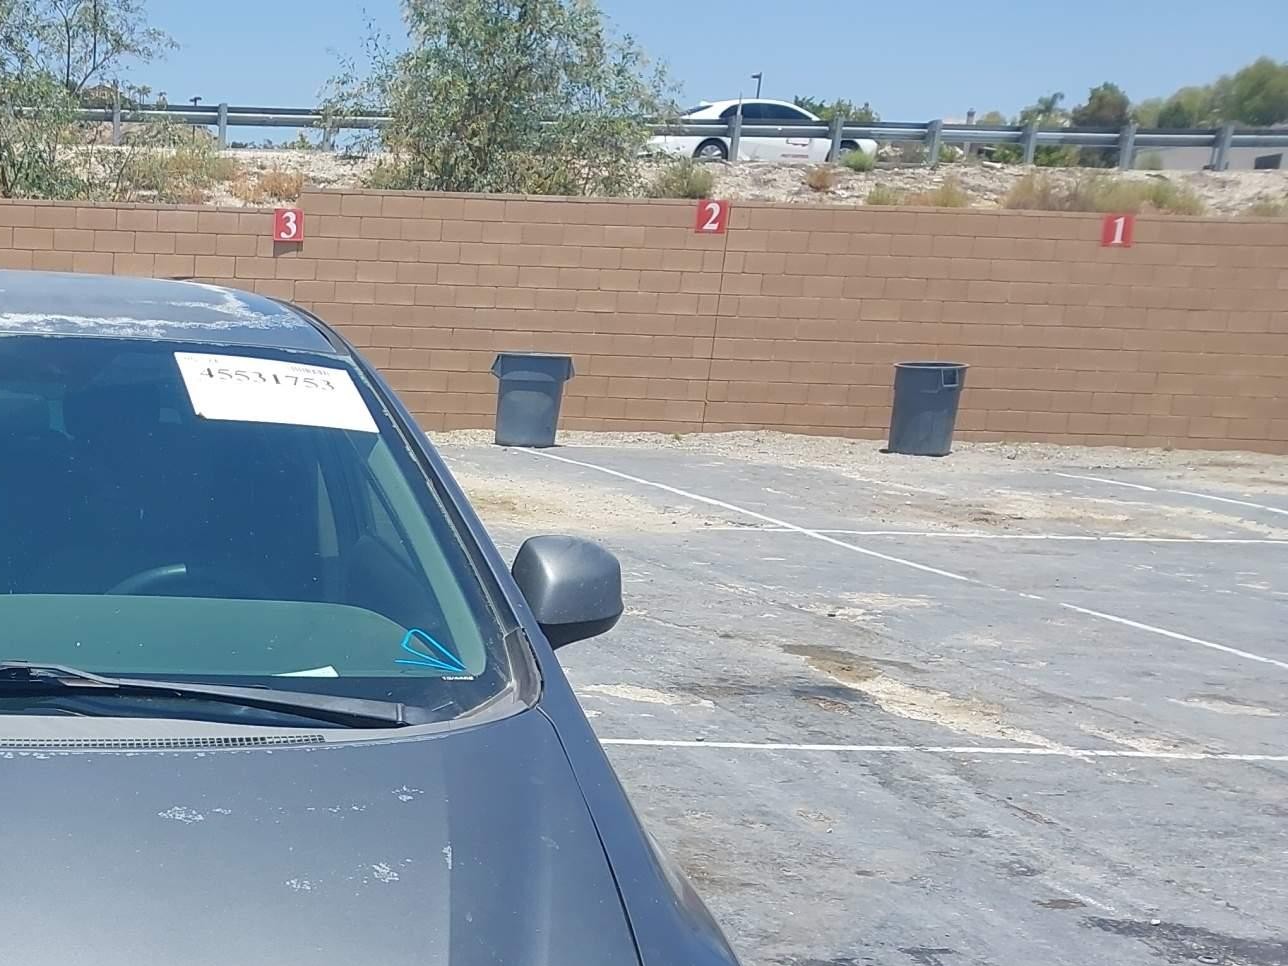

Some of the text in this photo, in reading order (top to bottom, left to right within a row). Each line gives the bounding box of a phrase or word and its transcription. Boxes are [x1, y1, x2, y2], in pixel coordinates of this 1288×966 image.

[280, 211, 297, 239] 3
[702, 202, 721, 230] 2
[1111, 216, 1125, 244] 1
[200, 367, 336, 391] 45531753
